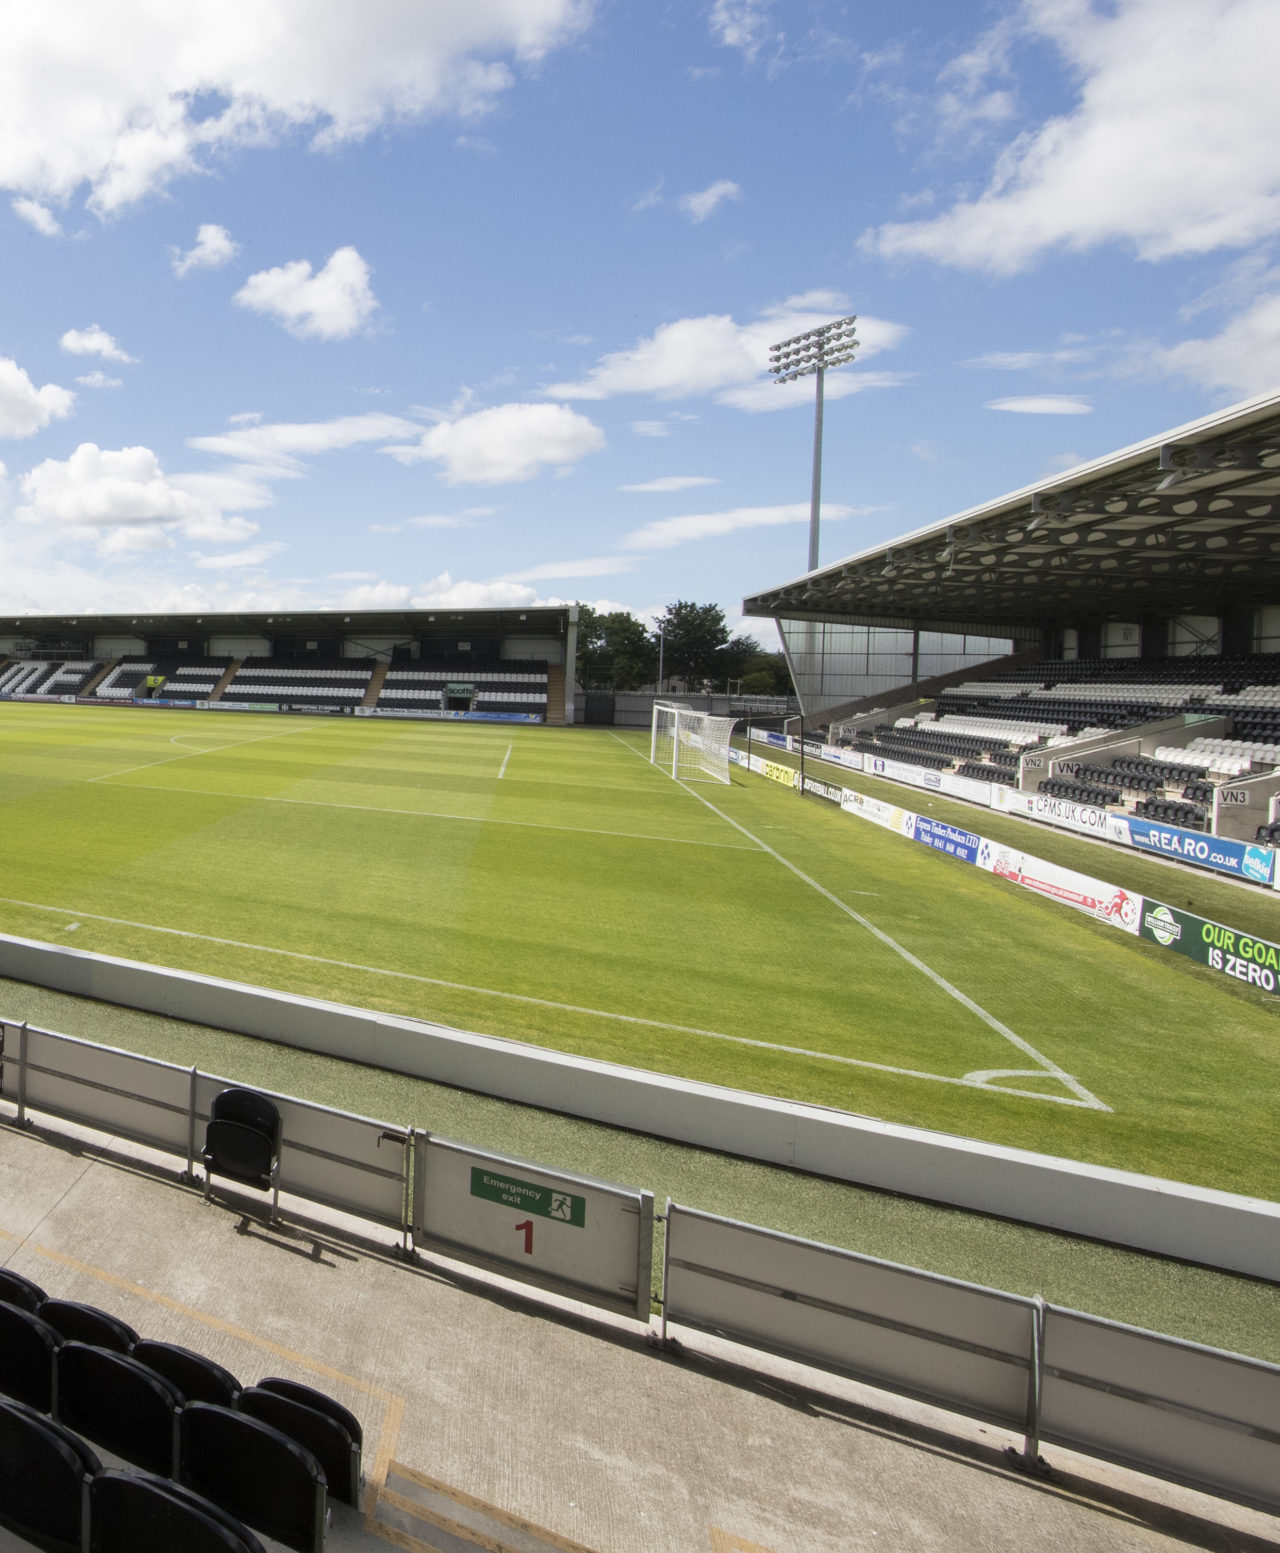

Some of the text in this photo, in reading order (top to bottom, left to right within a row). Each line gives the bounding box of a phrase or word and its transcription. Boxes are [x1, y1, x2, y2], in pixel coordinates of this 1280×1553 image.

[1024, 758, 1042, 767] VN2
[1221, 790, 1246, 803] VN3
[1036, 797, 1108, 830] CPMS.UK.COM
[966, 834, 979, 848] LTD
[1201, 923, 1280, 972] OUR GOA
[1208, 946, 1223, 970] IS
[1224, 953, 1274, 992] ZERO
[483, 1175, 542, 1200] Emergency
[502, 1193, 521, 1205] exit
[515, 1219, 534, 1255] 1
